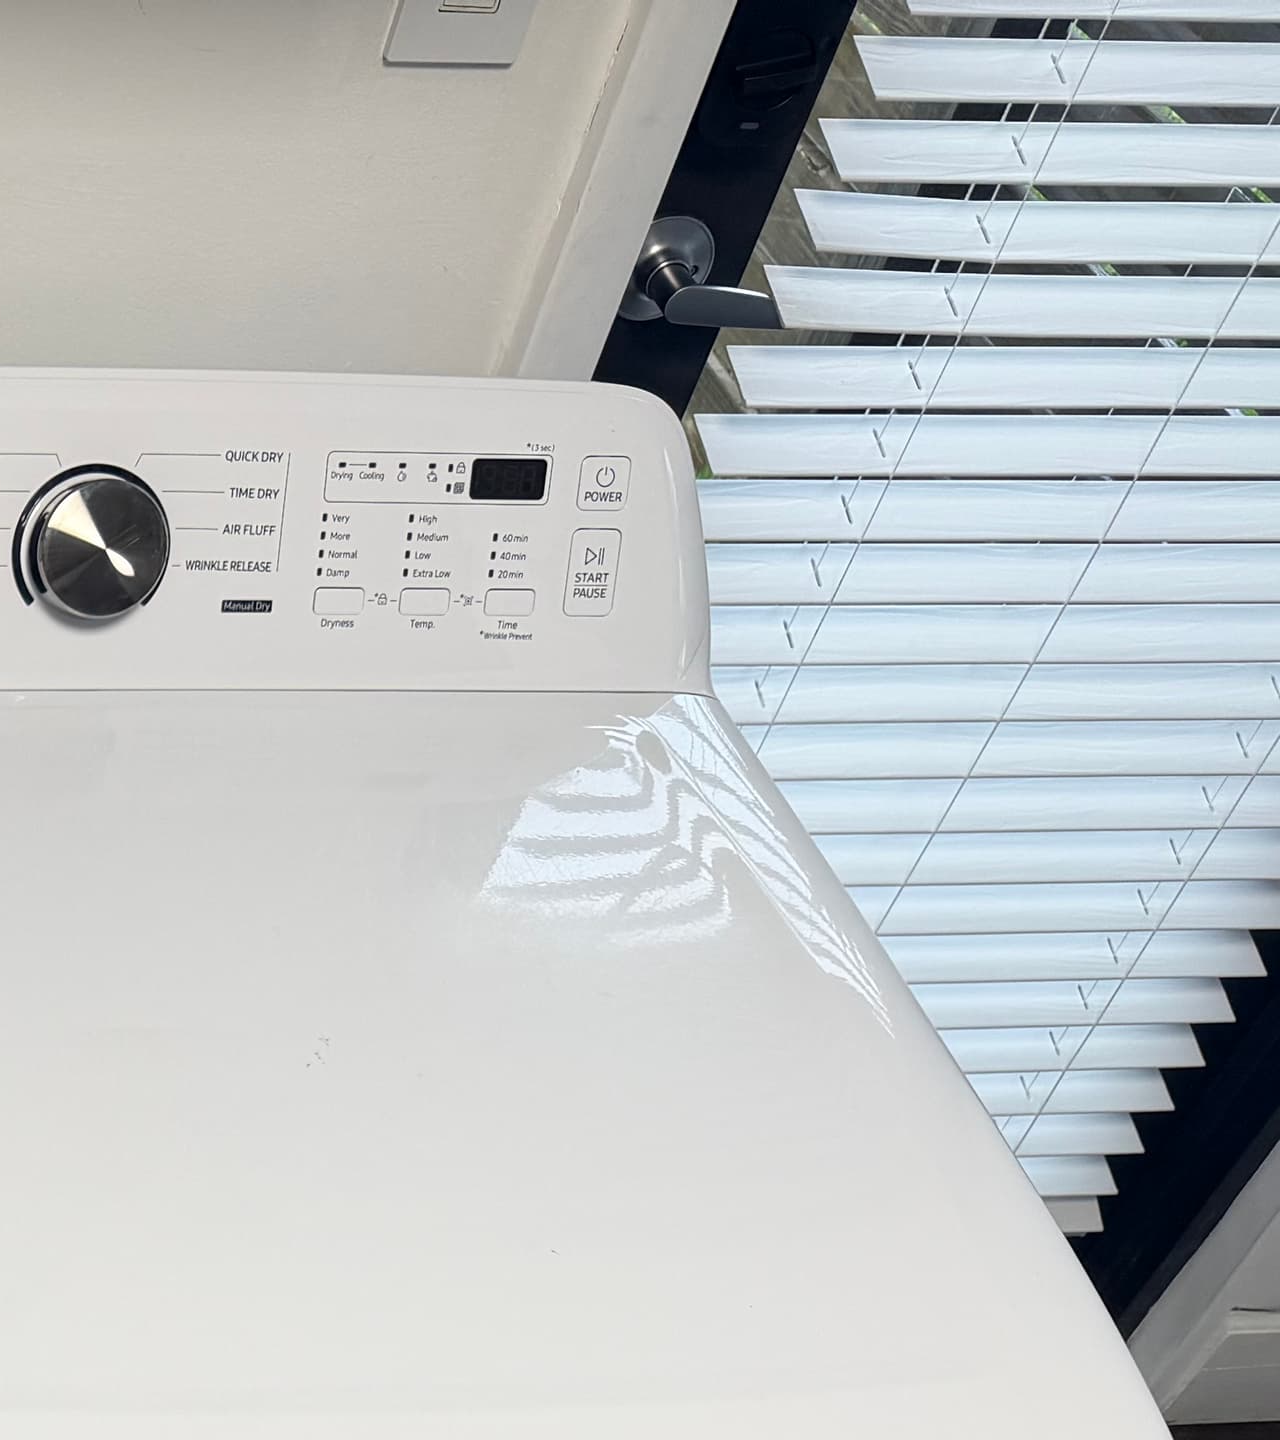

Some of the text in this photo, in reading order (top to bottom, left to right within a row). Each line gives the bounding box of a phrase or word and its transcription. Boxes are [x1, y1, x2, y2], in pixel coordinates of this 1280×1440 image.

[539, 444, 555, 452] sec)
[226, 450, 284, 463] QUICK DRY
[331, 471, 353, 481] Drying
[359, 471, 384, 481] Cooling
[230, 488, 280, 499] TIME DRY
[584, 492, 622, 503] POWER
[332, 514, 350, 524] Very
[419, 515, 438, 525] High
[222, 524, 276, 536] AIR FLUFF
[330, 532, 351, 540] More
[417, 533, 448, 542] Medium
[328, 550, 358, 559] Normal
[415, 552, 431, 560] Low
[185, 560, 272, 572] WRINKLE RELEASE
[326, 568, 350, 579] Damp
[413, 569, 450, 578] Extra Low
[574, 573, 609, 584] START
[573, 588, 608, 599] PAUSE
[223, 601, 271, 613] Manual Dry
[320, 618, 354, 629] Dryness
[410, 619, 436, 630] Temp.
[498, 620, 518, 630] Time
[509, 633, 532, 641] Prevent
